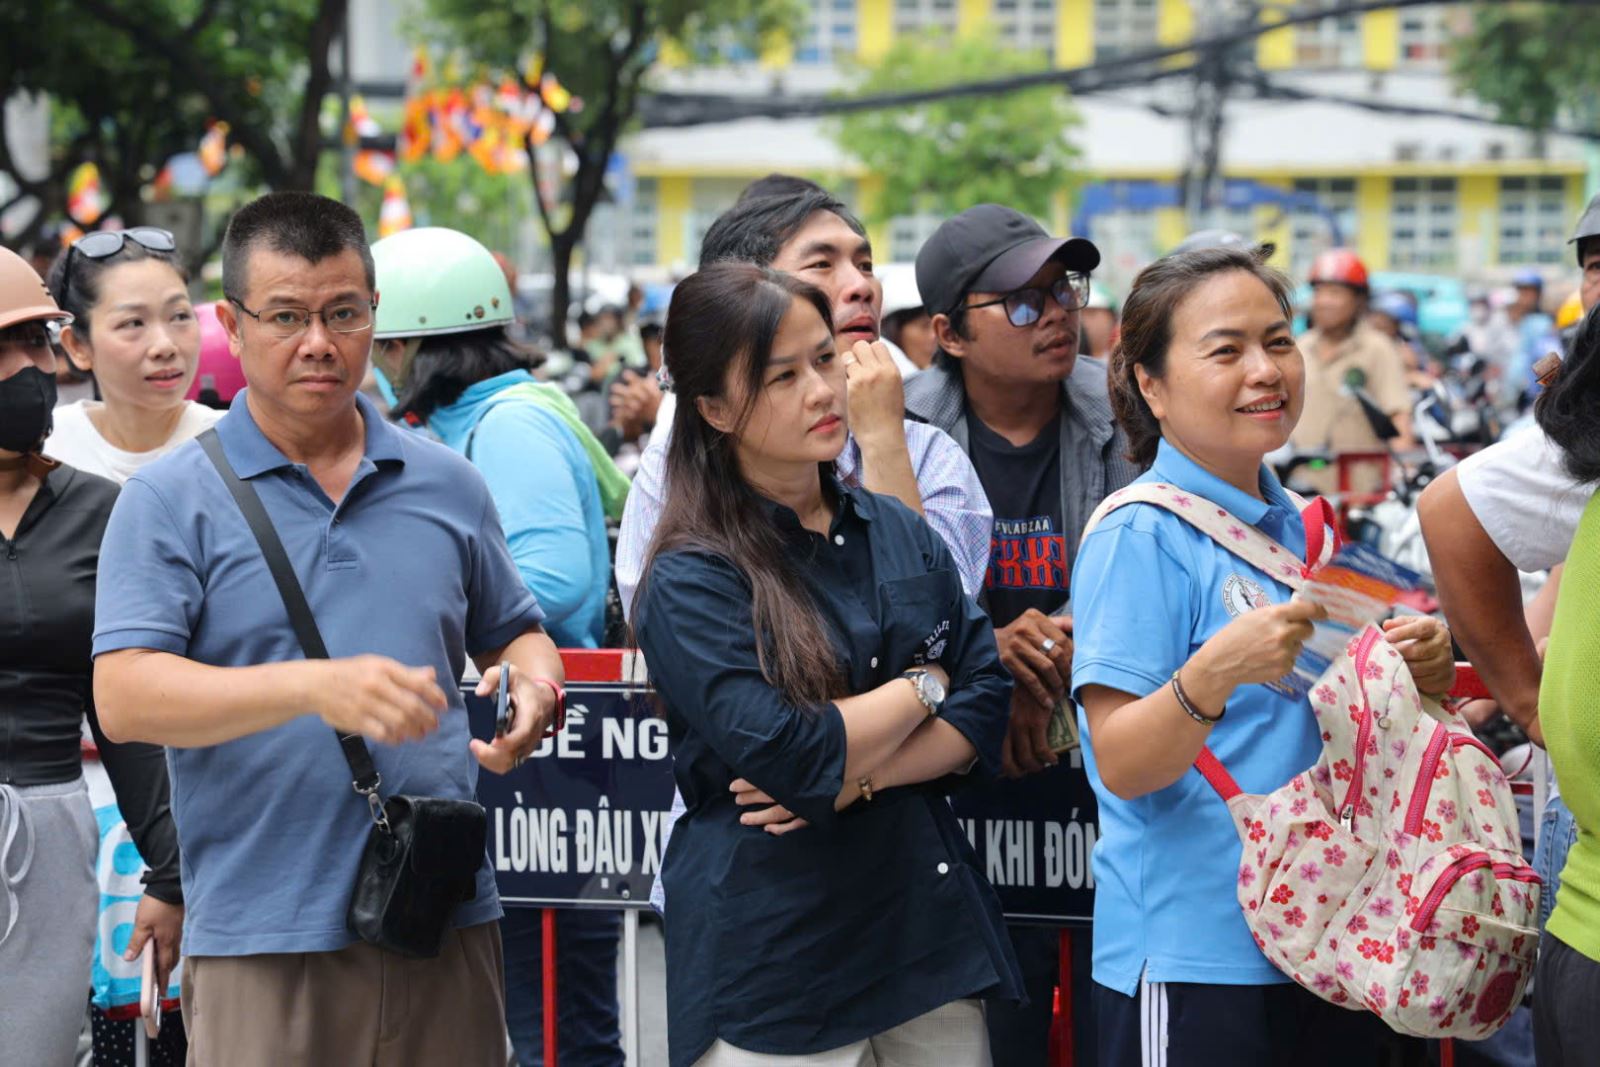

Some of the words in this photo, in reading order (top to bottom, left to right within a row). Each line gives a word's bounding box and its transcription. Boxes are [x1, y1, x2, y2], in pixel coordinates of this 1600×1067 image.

[494, 791, 568, 873] LÒNG
[575, 795, 633, 889] ĐẬU
[985, 819, 1035, 886] KHI
